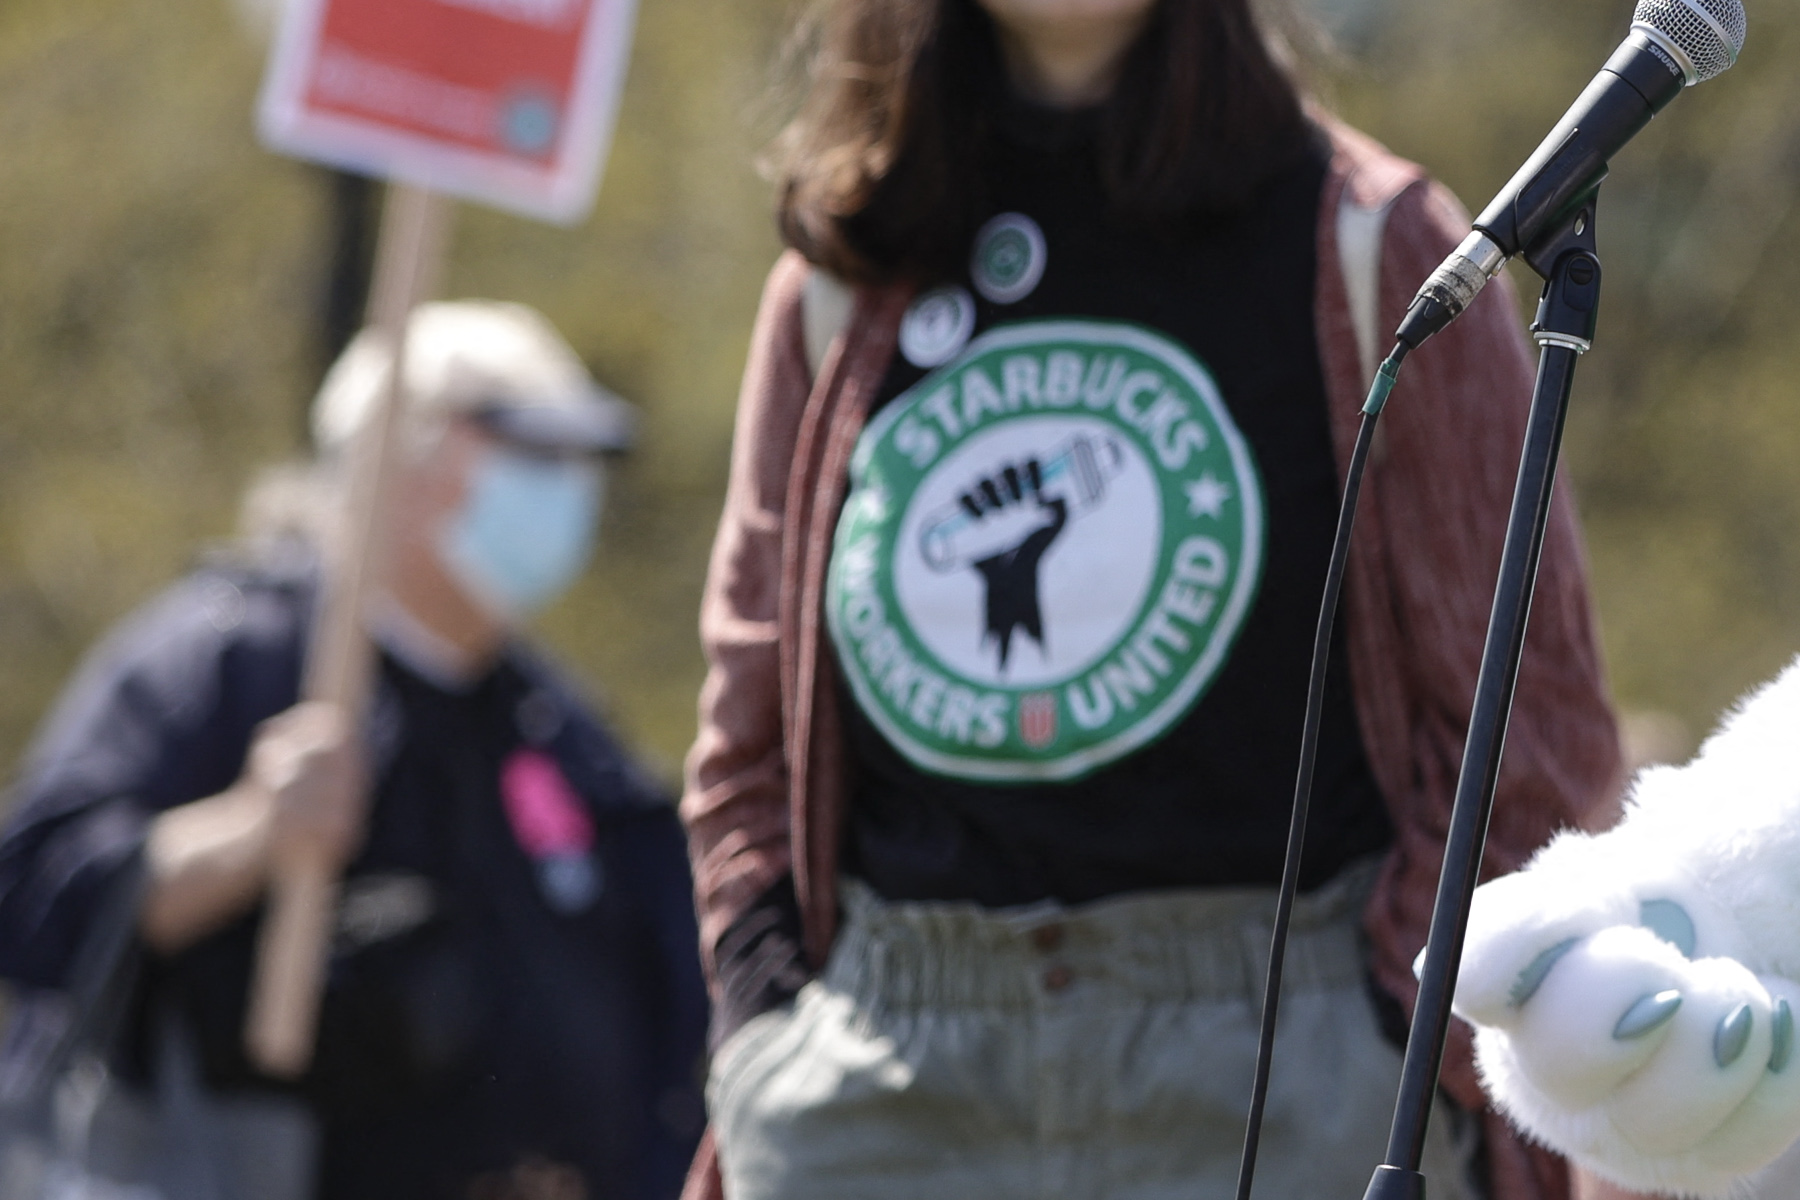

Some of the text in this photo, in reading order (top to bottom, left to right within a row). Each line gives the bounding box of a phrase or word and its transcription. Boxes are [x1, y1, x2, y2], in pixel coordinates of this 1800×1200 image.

[1648, 45, 1680, 76] SHURE
[893, 351, 1208, 470] STARBUCKS
[1065, 535, 1230, 729] UNITED
